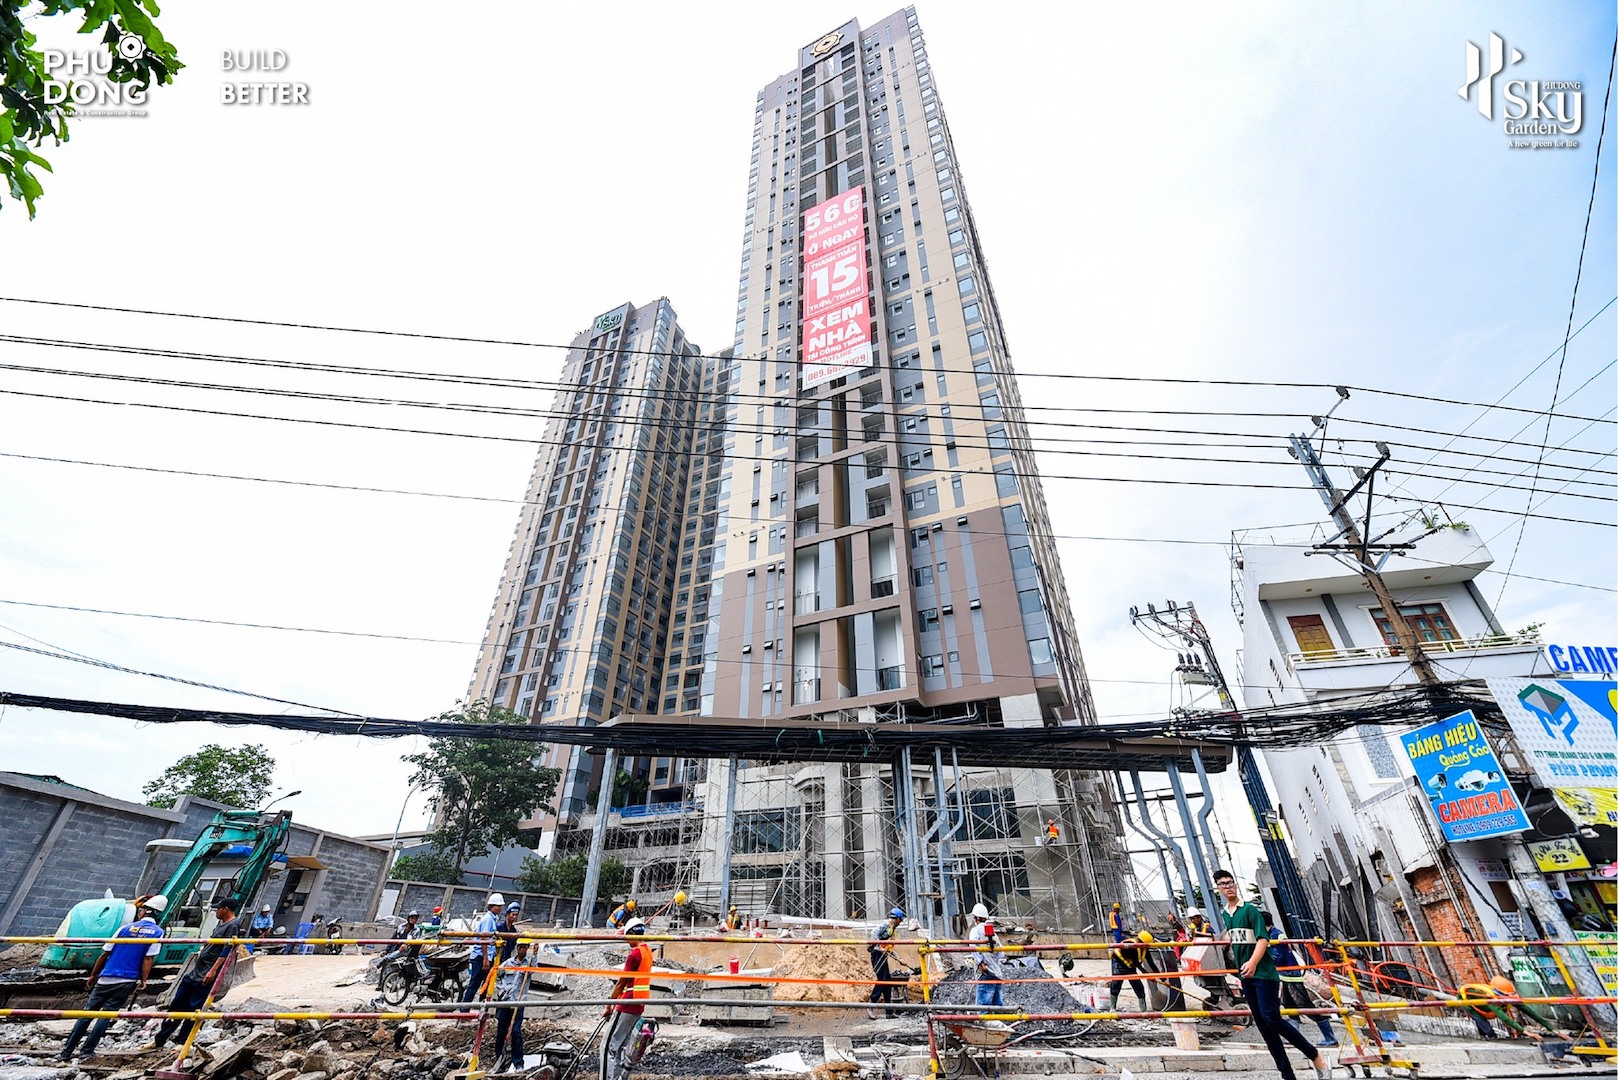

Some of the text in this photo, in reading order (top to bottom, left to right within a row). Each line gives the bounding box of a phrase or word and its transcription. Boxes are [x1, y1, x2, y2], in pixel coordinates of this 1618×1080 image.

[822, 225, 859, 250] NGAY
[810, 253, 859, 300] 15
[809, 301, 864, 335] XEM
[808, 319, 863, 353] NHÀ
[820, 348, 853, 363] HOTLINE
[1407, 721, 1477, 759] BẢNG HIỆU
[1438, 788, 1518, 824] CAMERA
[1551, 853, 1570, 864] 22
